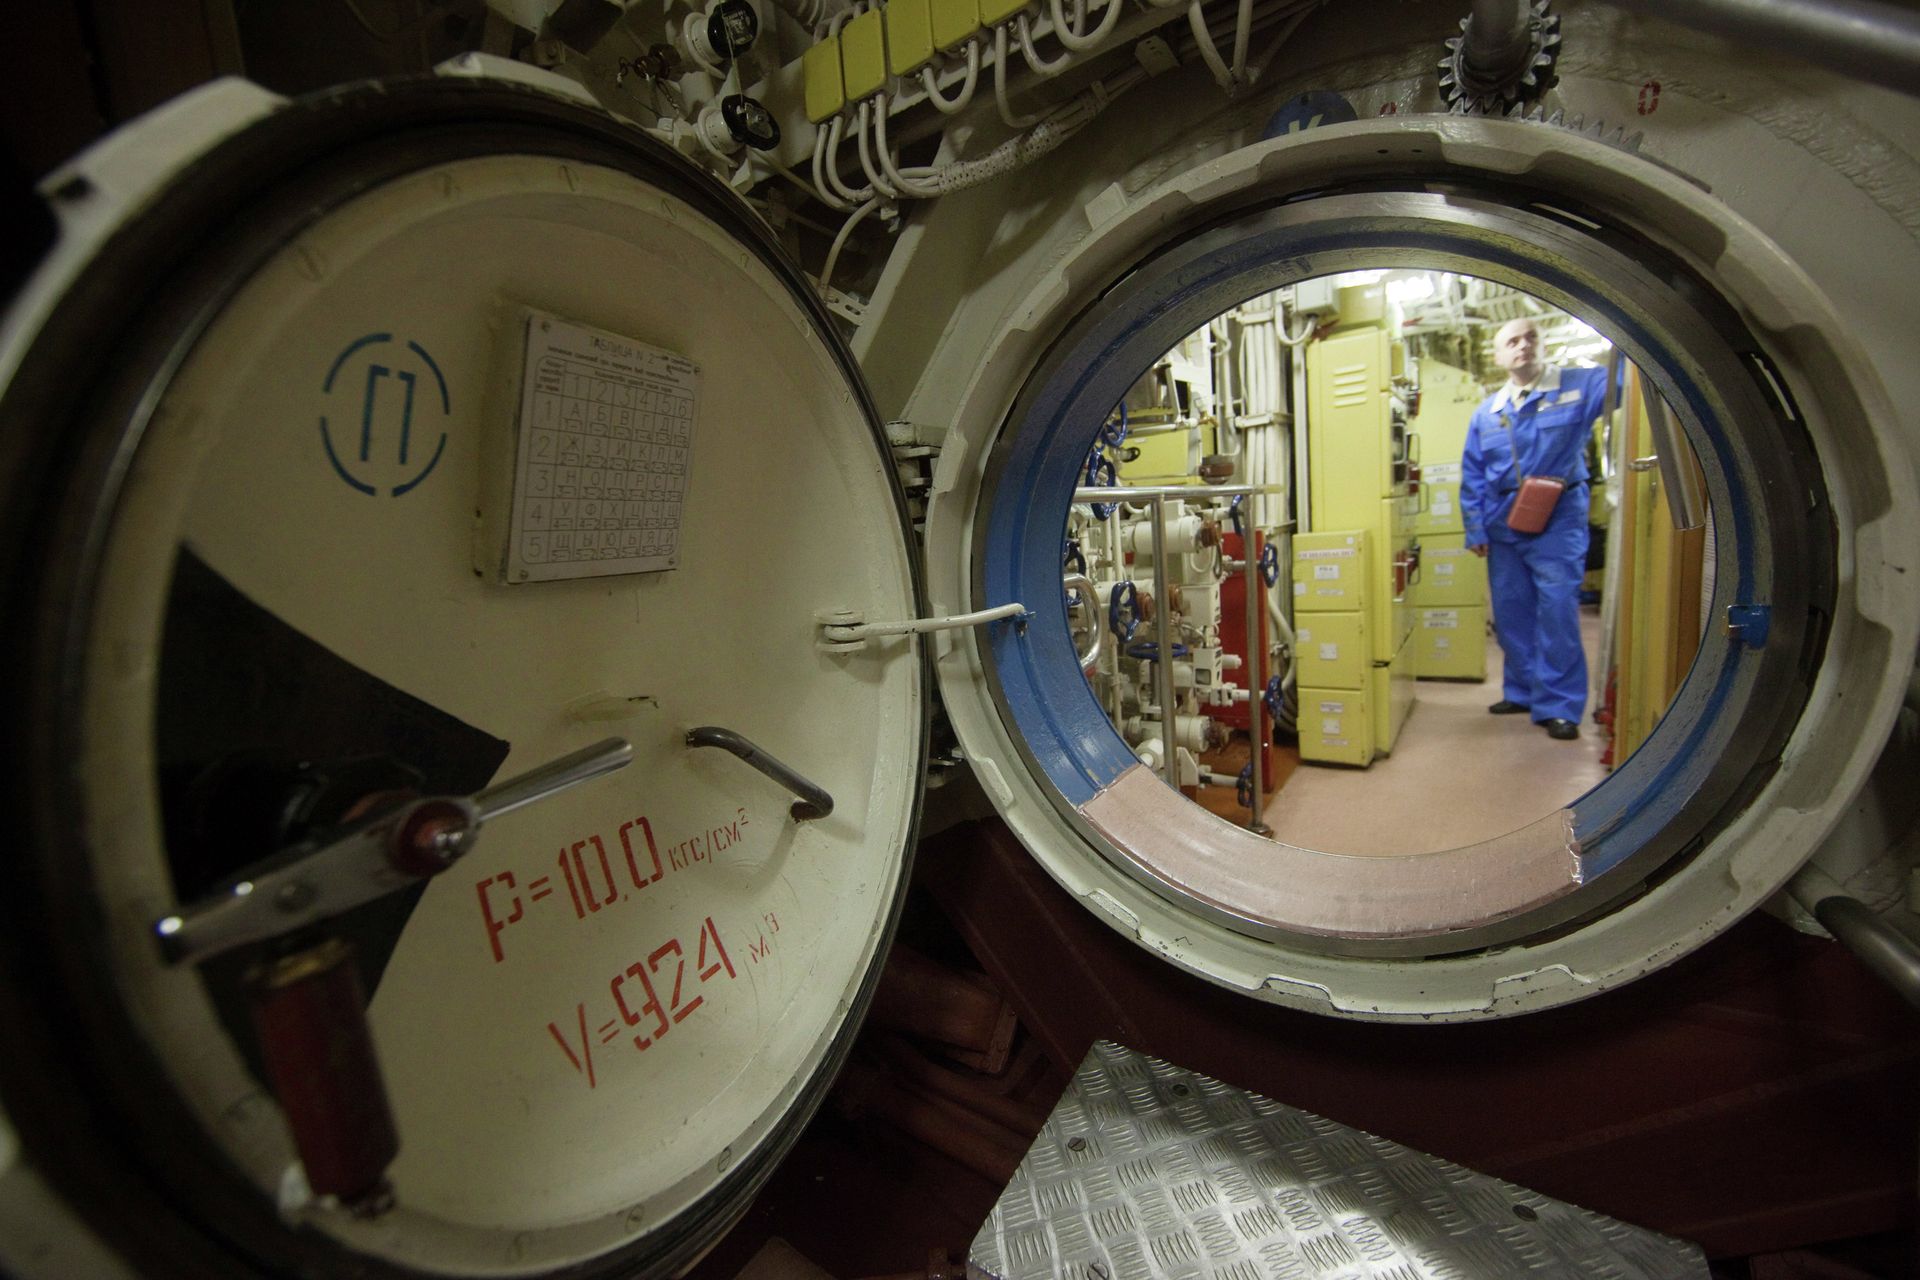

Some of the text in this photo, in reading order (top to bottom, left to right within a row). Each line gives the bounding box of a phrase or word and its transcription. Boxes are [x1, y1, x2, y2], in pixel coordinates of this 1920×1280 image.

[573, 376, 580, 395] 1
[595, 380, 608, 402] 2
[619, 386, 631, 406] 3
[638, 390, 648, 408] 4
[661, 395, 671, 413] 5
[678, 400, 687, 416] 6
[543, 399, 552, 421] 1
[536, 435, 551, 458] 2
[534, 469, 549, 491] 3
[530, 503, 543, 524] 4
[528, 536, 542, 557] 5
